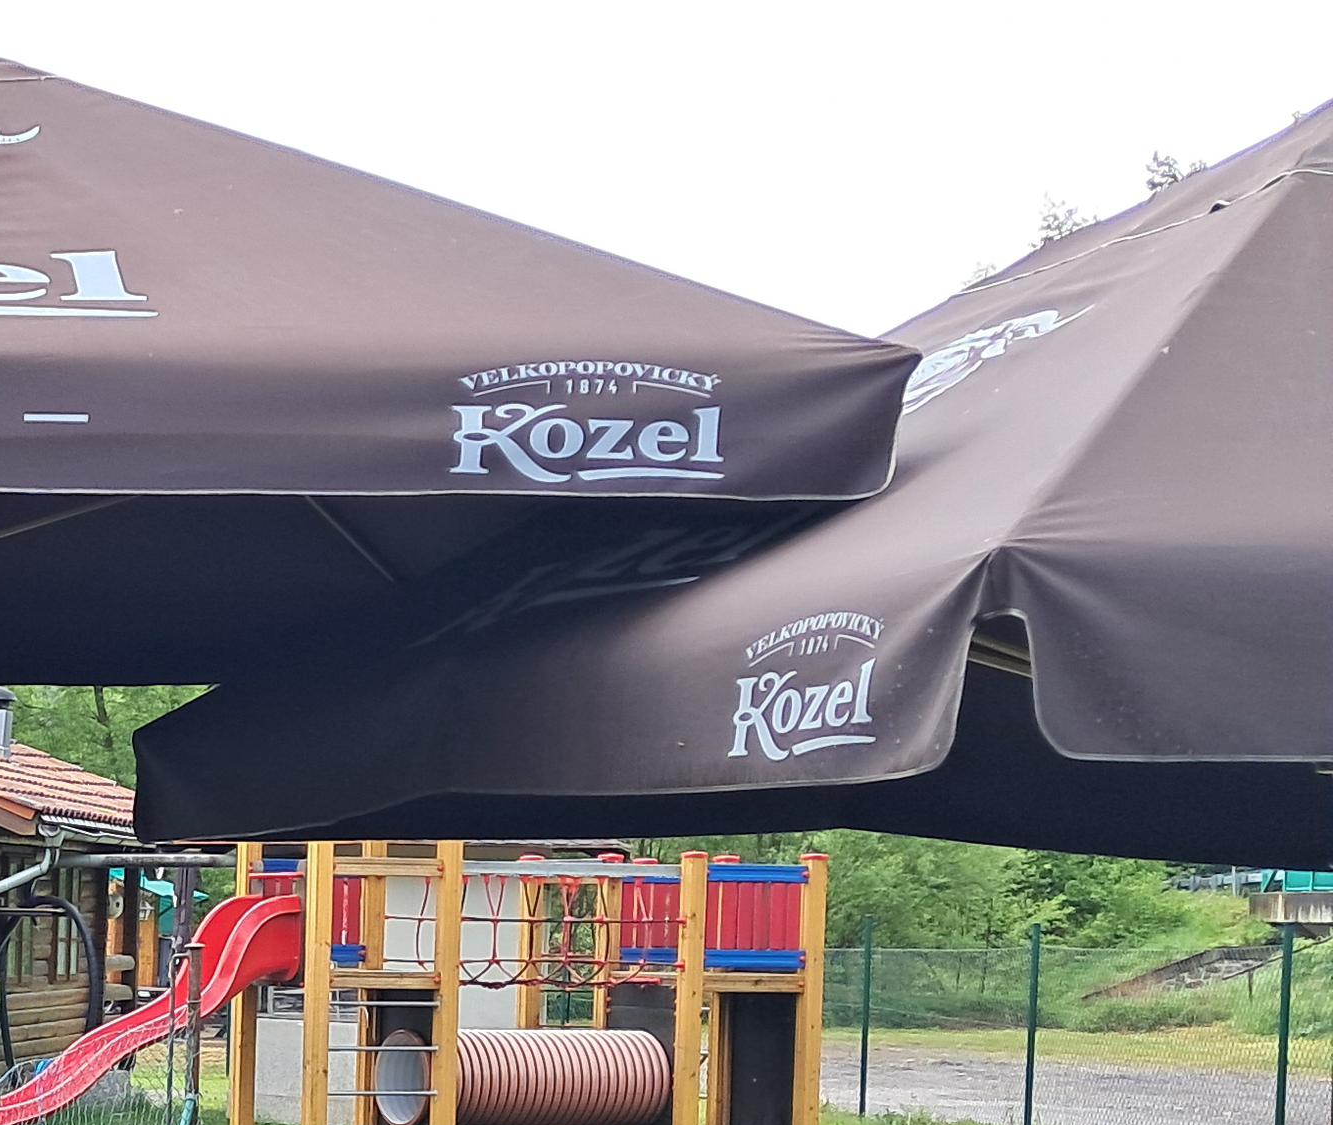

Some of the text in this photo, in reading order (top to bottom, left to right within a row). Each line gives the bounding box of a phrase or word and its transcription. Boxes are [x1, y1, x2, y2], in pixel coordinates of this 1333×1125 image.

[459, 361, 722, 392] VELKOPOPOVICKÝ
[565, 379, 619, 395] 1874
[449, 403, 725, 483] Kozel
[745, 612, 884, 659] VELKOPOPOVICKÝ
[799, 635, 829, 656] 1874
[727, 657, 877, 761] Kozel
